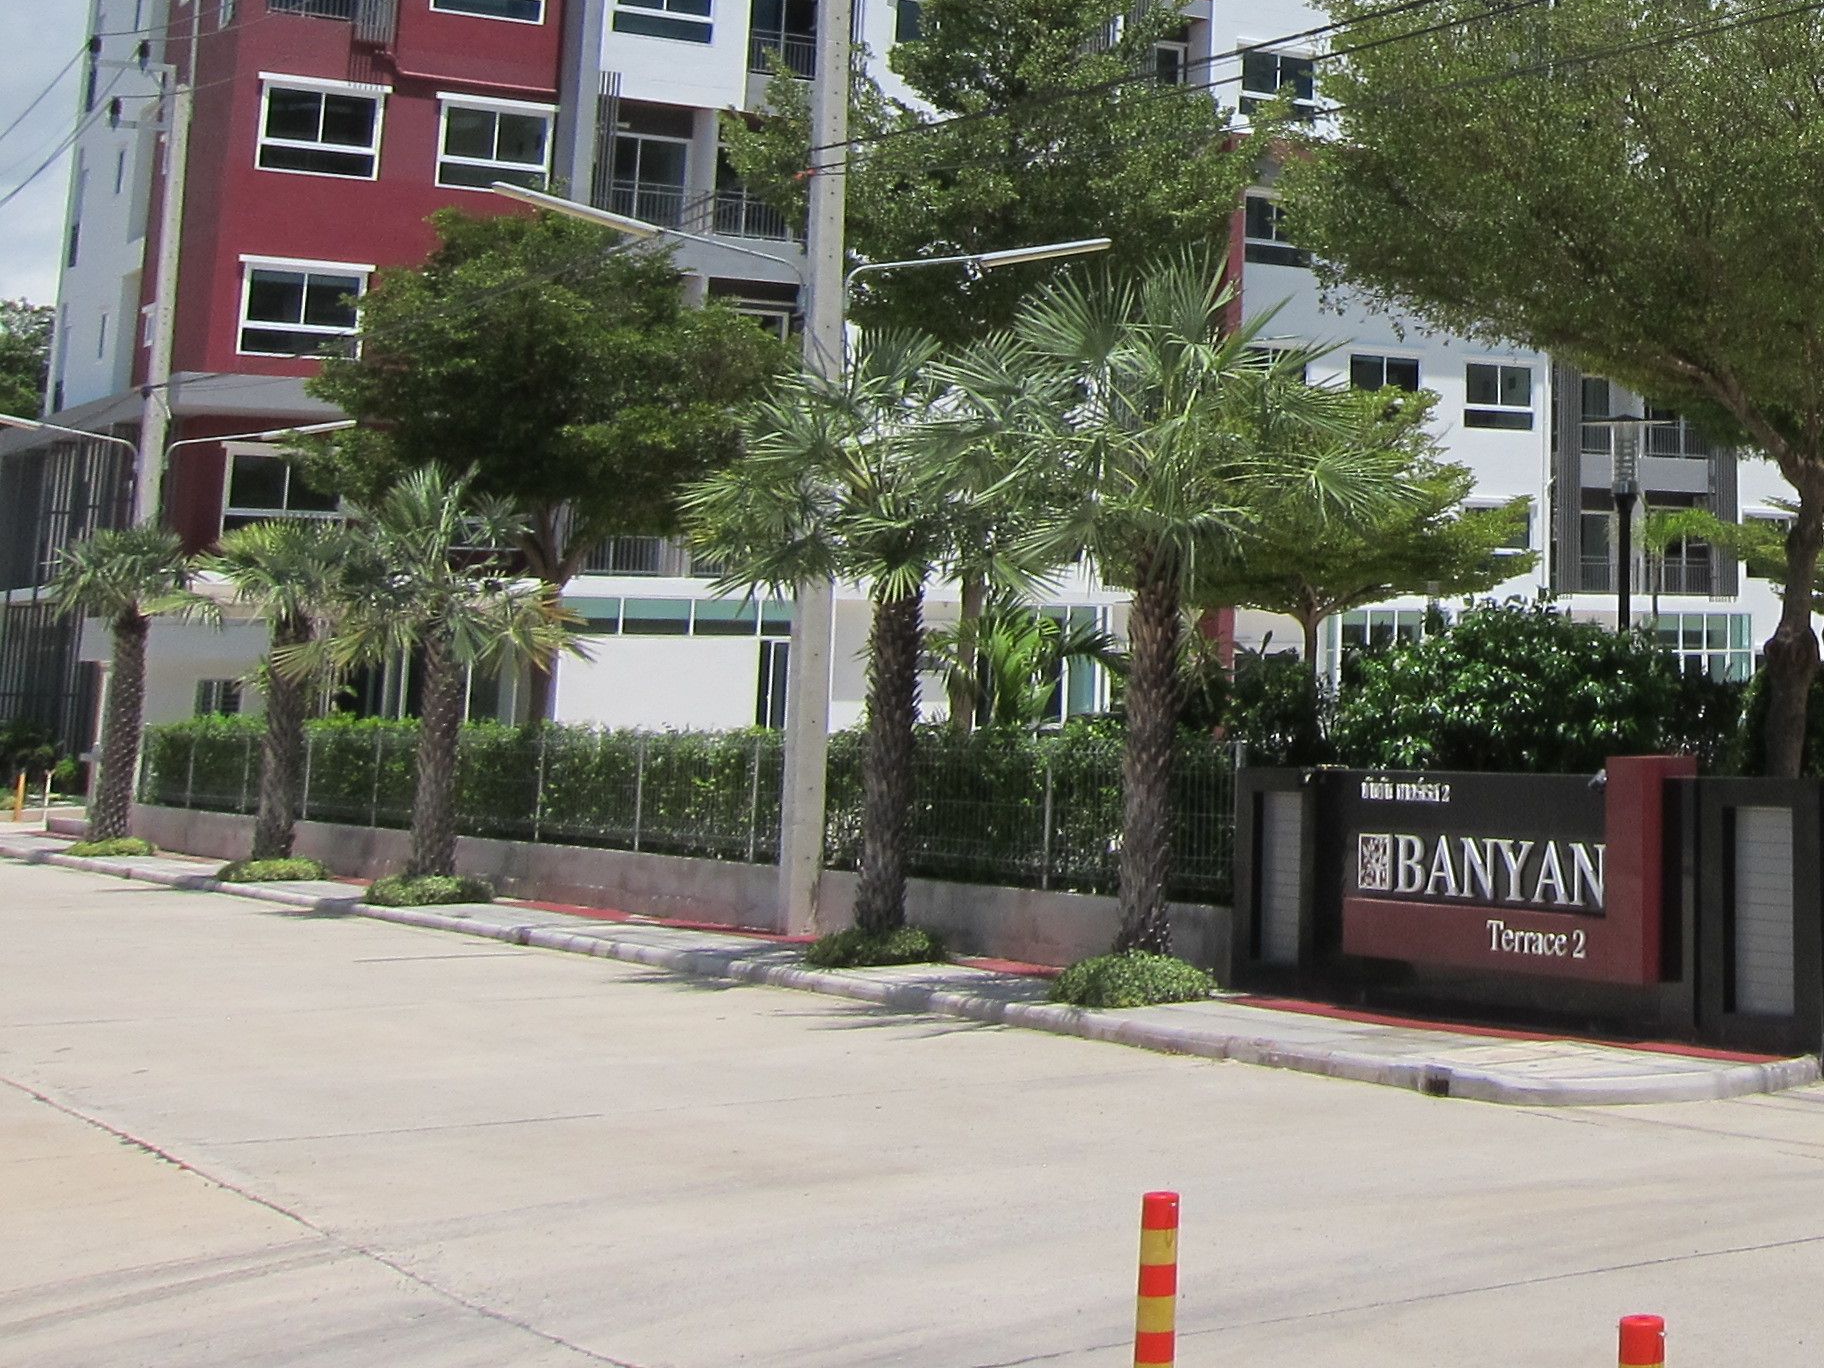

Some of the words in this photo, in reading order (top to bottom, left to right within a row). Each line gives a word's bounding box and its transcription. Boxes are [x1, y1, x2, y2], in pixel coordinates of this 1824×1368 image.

[1442, 784, 1450, 802] 2
[1393, 834, 1607, 909] BANYAN
[1486, 920, 1568, 957] Terrace
[1572, 929, 1587, 959] 2
